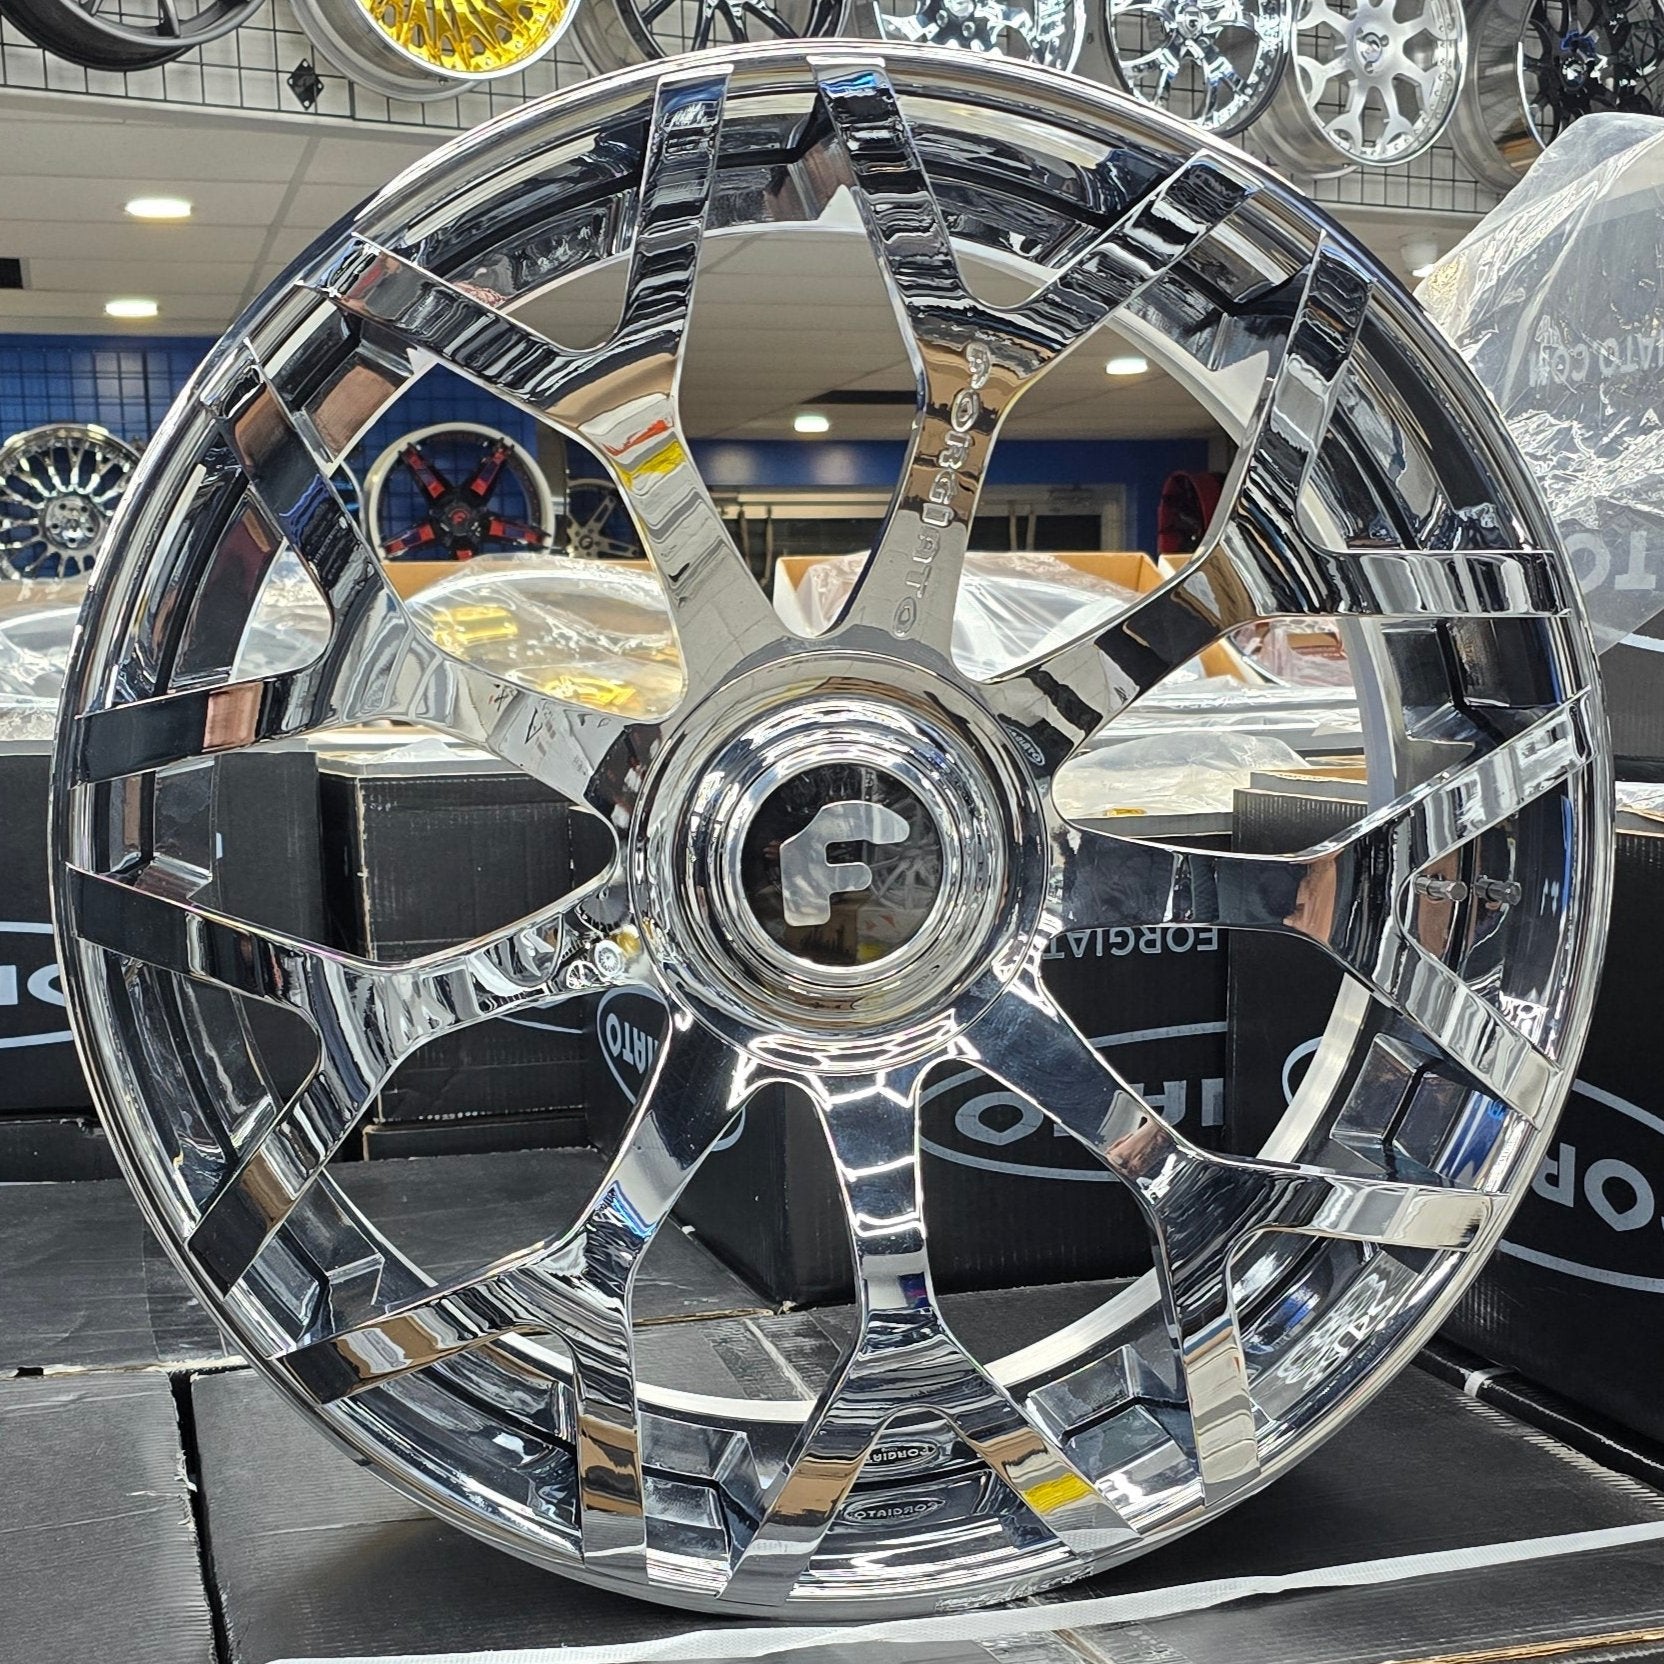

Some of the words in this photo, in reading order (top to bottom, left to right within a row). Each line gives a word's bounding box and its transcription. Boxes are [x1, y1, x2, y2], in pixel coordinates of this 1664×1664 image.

[892, 341, 992, 639] FORGIATO
[780, 800, 911, 927] F
[1042, 926, 1218, 959] FORGIAT
[605, 1012, 660, 1075] IATO
[866, 1445, 930, 1464] FORGIAT
